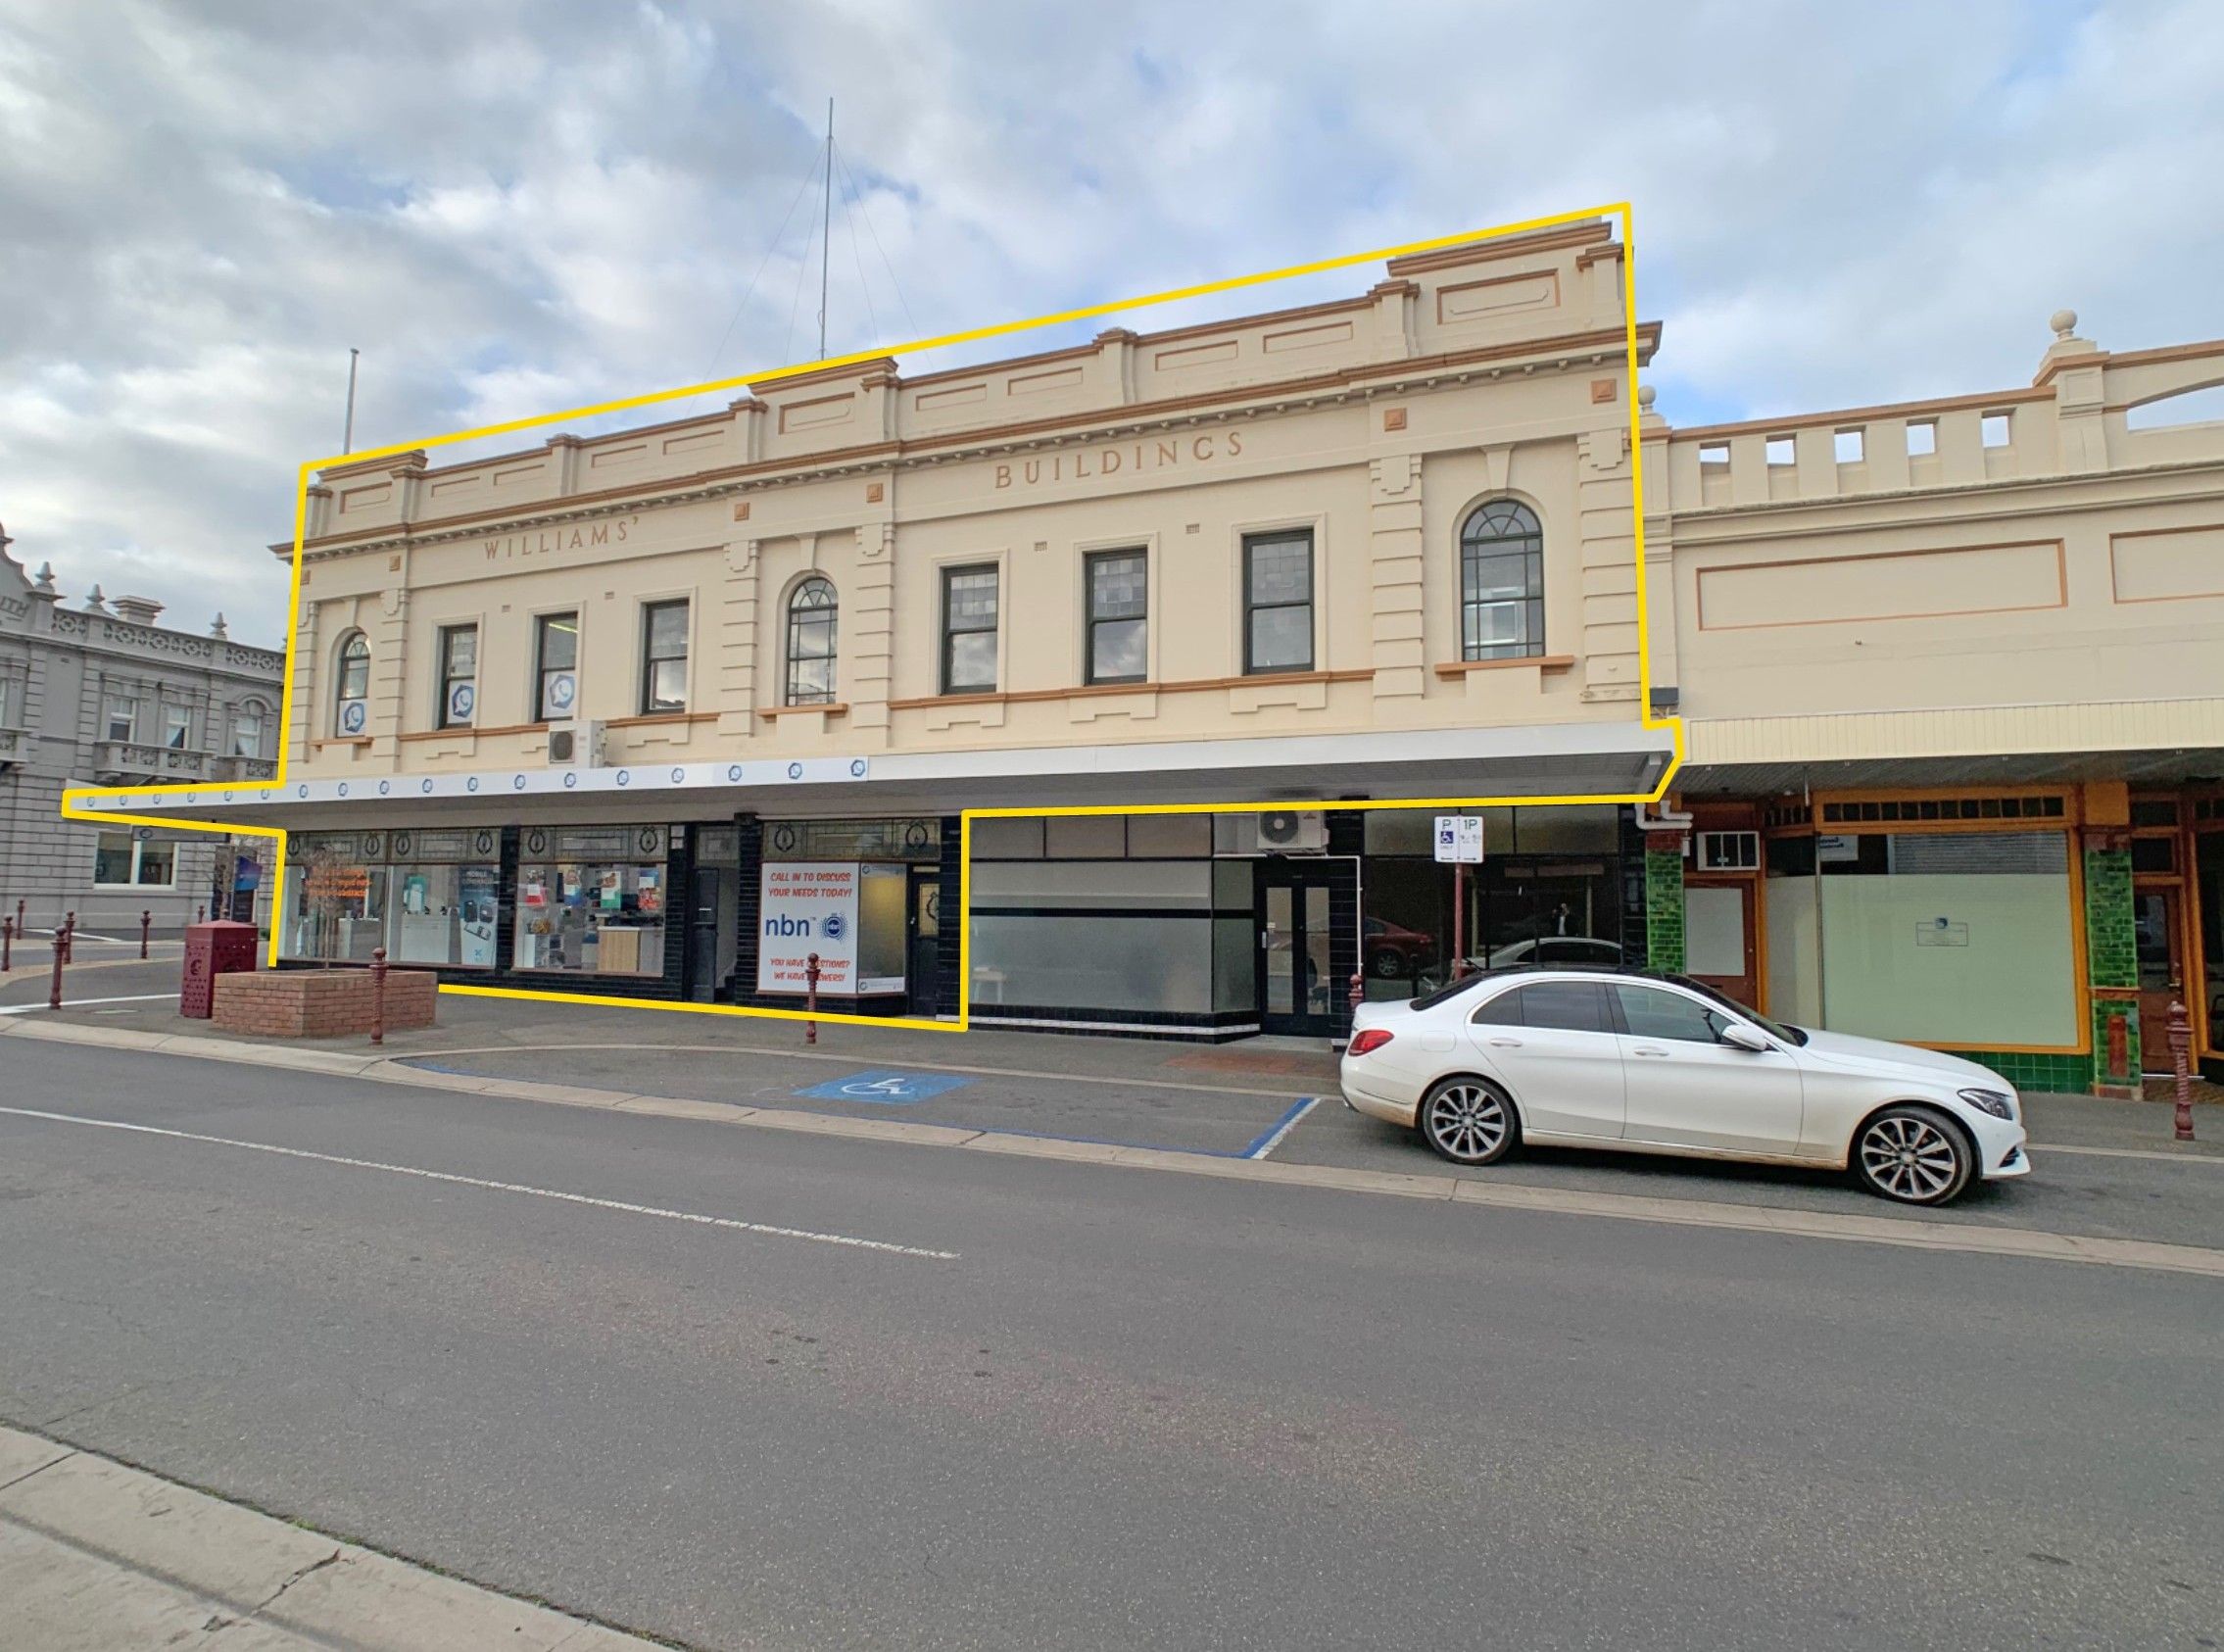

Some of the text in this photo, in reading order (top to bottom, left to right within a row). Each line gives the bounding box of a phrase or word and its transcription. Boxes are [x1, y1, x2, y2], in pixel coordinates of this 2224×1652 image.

[994, 431, 1242, 488] BUILDINGS
[1442, 818, 1451, 829] P
[1464, 818, 1477, 830] 1P
[770, 872, 851, 882] CALL IN TO DISCUSS
[768, 888, 852, 899] YOUR NEEDS TODAY!
[770, 957, 785, 967] YOU
[786, 958, 805, 968] HAVE
[774, 971, 846, 983] WE HAVE SWERS!
